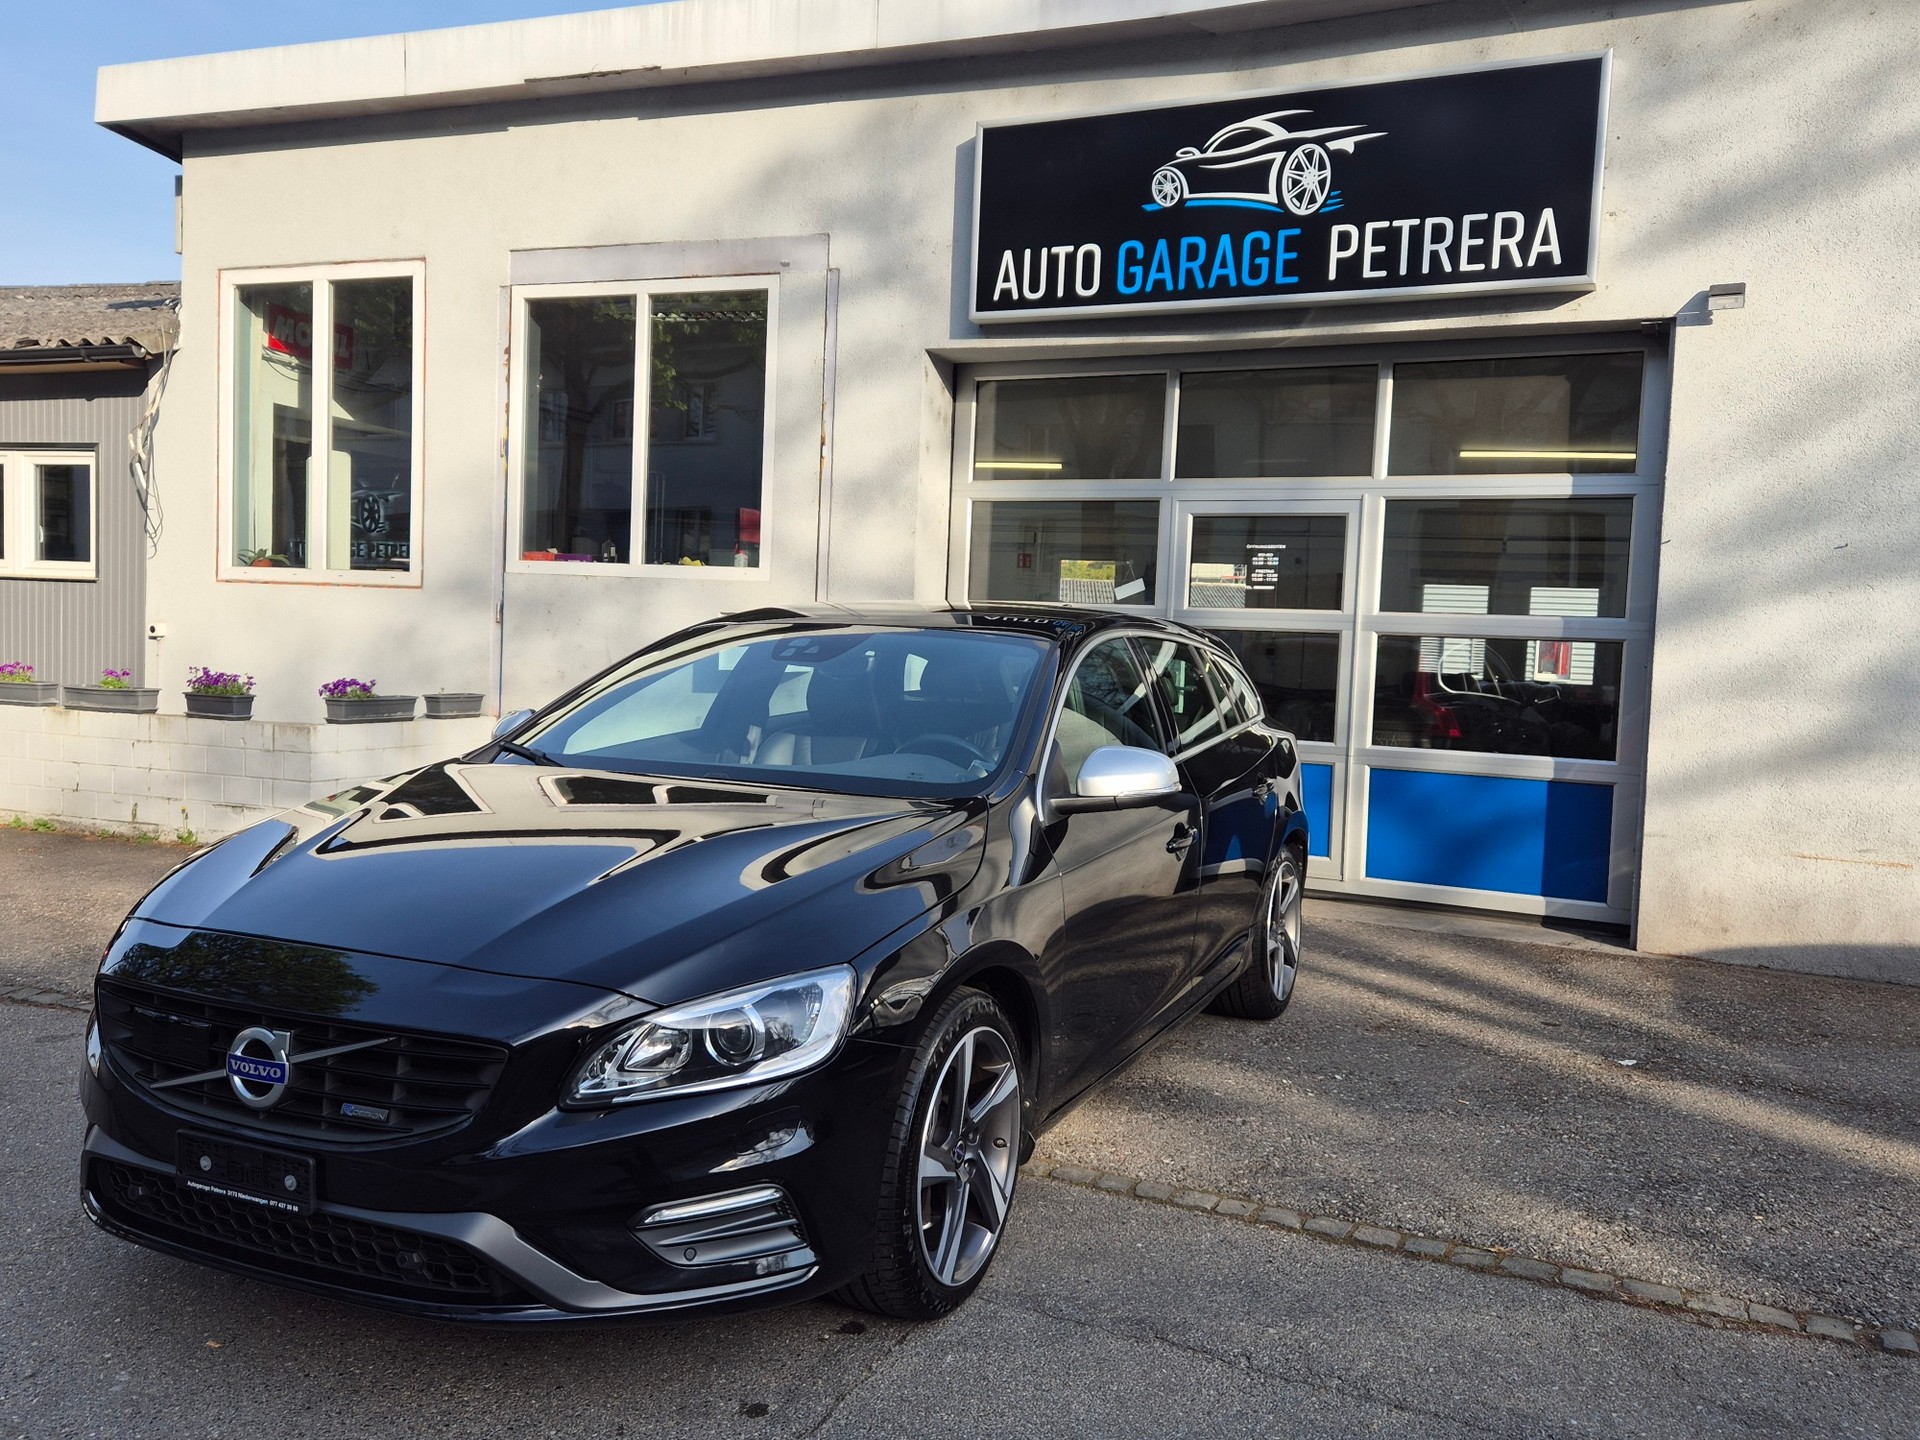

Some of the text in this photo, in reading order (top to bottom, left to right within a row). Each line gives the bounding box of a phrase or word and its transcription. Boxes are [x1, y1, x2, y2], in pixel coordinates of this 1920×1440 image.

[993, 207, 1562, 302] AUTO GARAGE PETRERA
[273, 315, 350, 359] MOL
[230, 1059, 281, 1078] VOLVO
